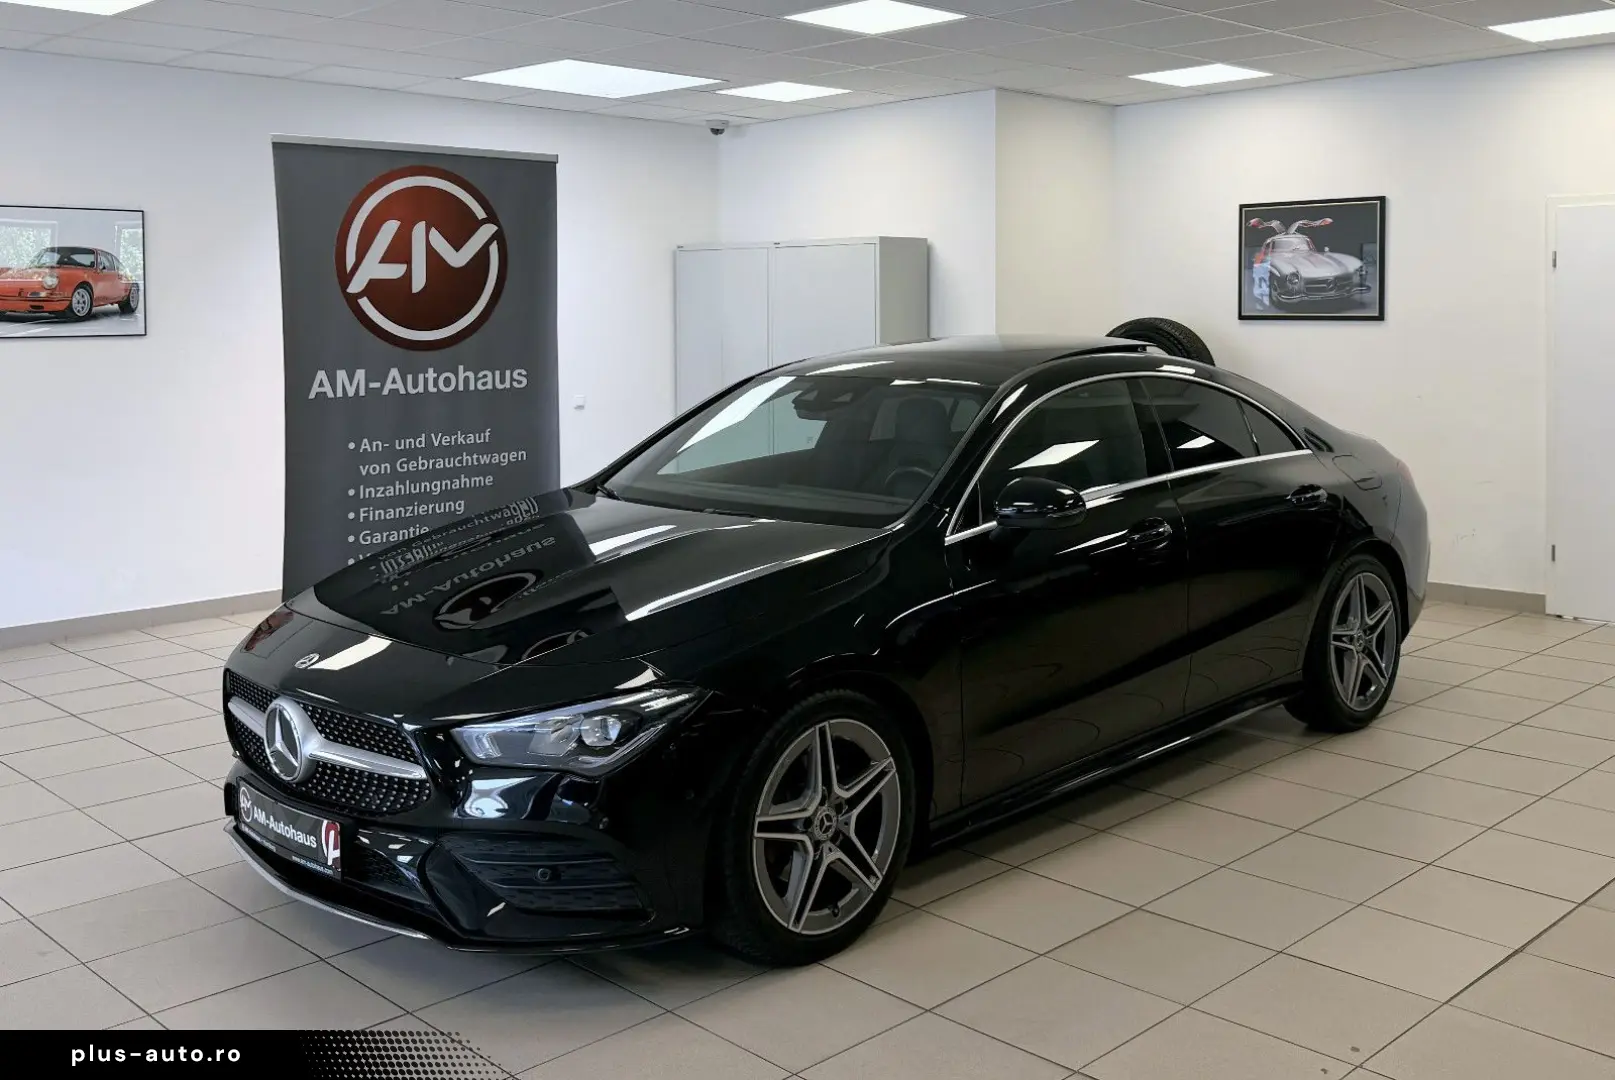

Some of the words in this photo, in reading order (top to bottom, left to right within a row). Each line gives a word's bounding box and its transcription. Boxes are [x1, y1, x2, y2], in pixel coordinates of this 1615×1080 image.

[308, 365, 528, 399] AM-Autohaus
[359, 438, 390, 452] An-
[395, 433, 426, 450] und
[431, 428, 491, 447] Verkauf
[359, 460, 391, 476] von
[396, 450, 527, 473] Gebrauchtwagen
[359, 474, 494, 499] Inzahlungnahme
[359, 499, 465, 522] Finanzierung
[359, 523, 430, 545] Garantie
[253, 806, 317, 848] AM-Autohaus
